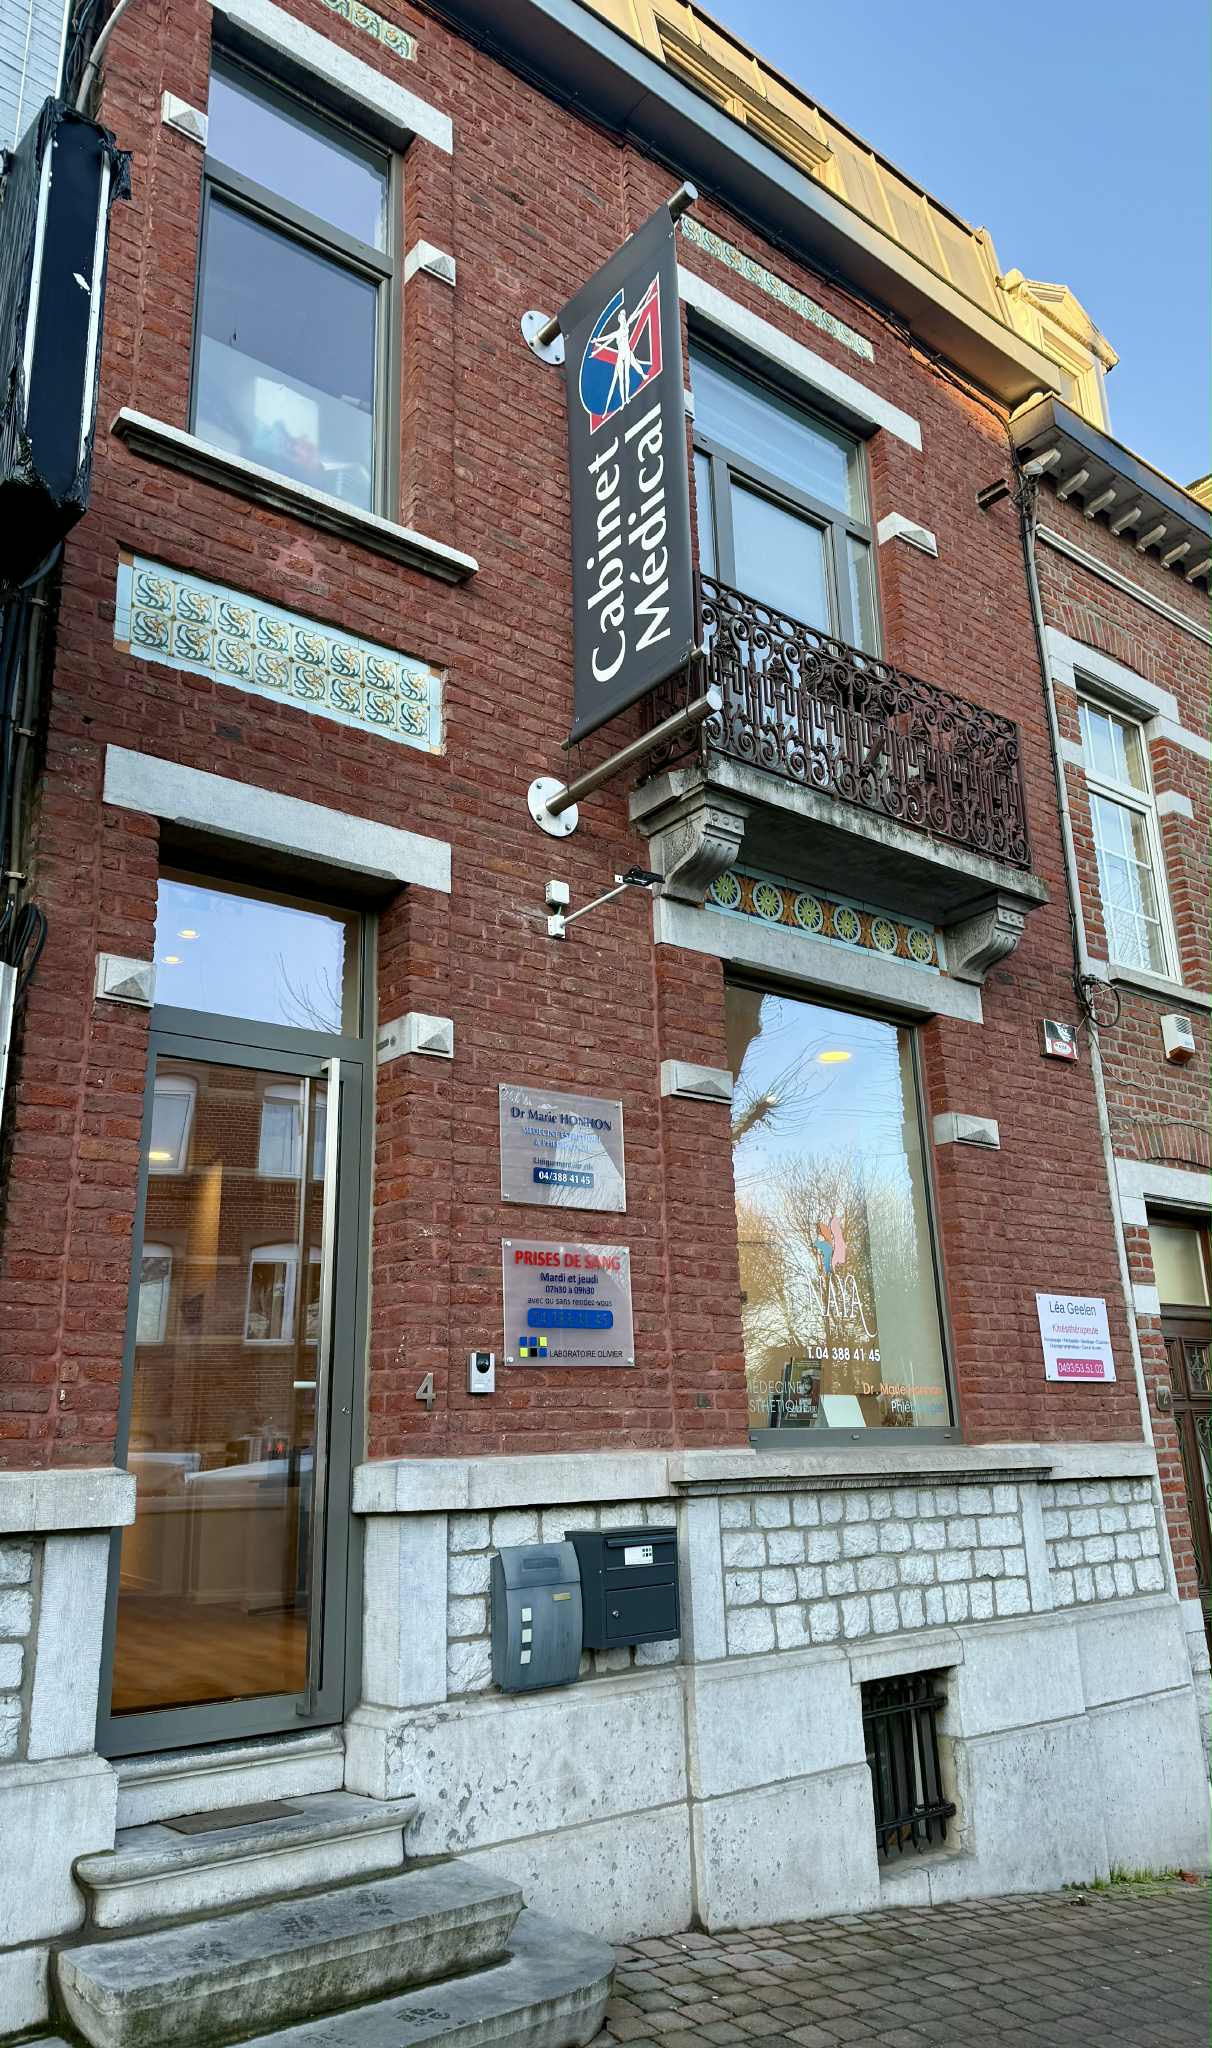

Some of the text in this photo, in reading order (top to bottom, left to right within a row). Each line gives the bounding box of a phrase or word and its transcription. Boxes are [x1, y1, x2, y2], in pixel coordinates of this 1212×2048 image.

[624, 402, 671, 652] Médical
[587, 436, 626, 683] Cabinet
[511, 1106, 612, 1131] Dr Marie HONHON
[538, 1170, 591, 1185] 04/388 41 45
[514, 1250, 621, 1271] PRISES DE SANG
[540, 1272, 599, 1286] Mardi et jeudi
[572, 1299, 613, 1307] rendez-vous
[1049, 1300, 1097, 1316] Léa Geelen
[549, 1350, 623, 1359] LABORATOIRE OLIVIER
[832, 1347, 850, 1361] 388
[853, 1348, 865, 1361] 41
[868, 1349, 881, 1362] 45
[415, 1372, 437, 1410] 4
